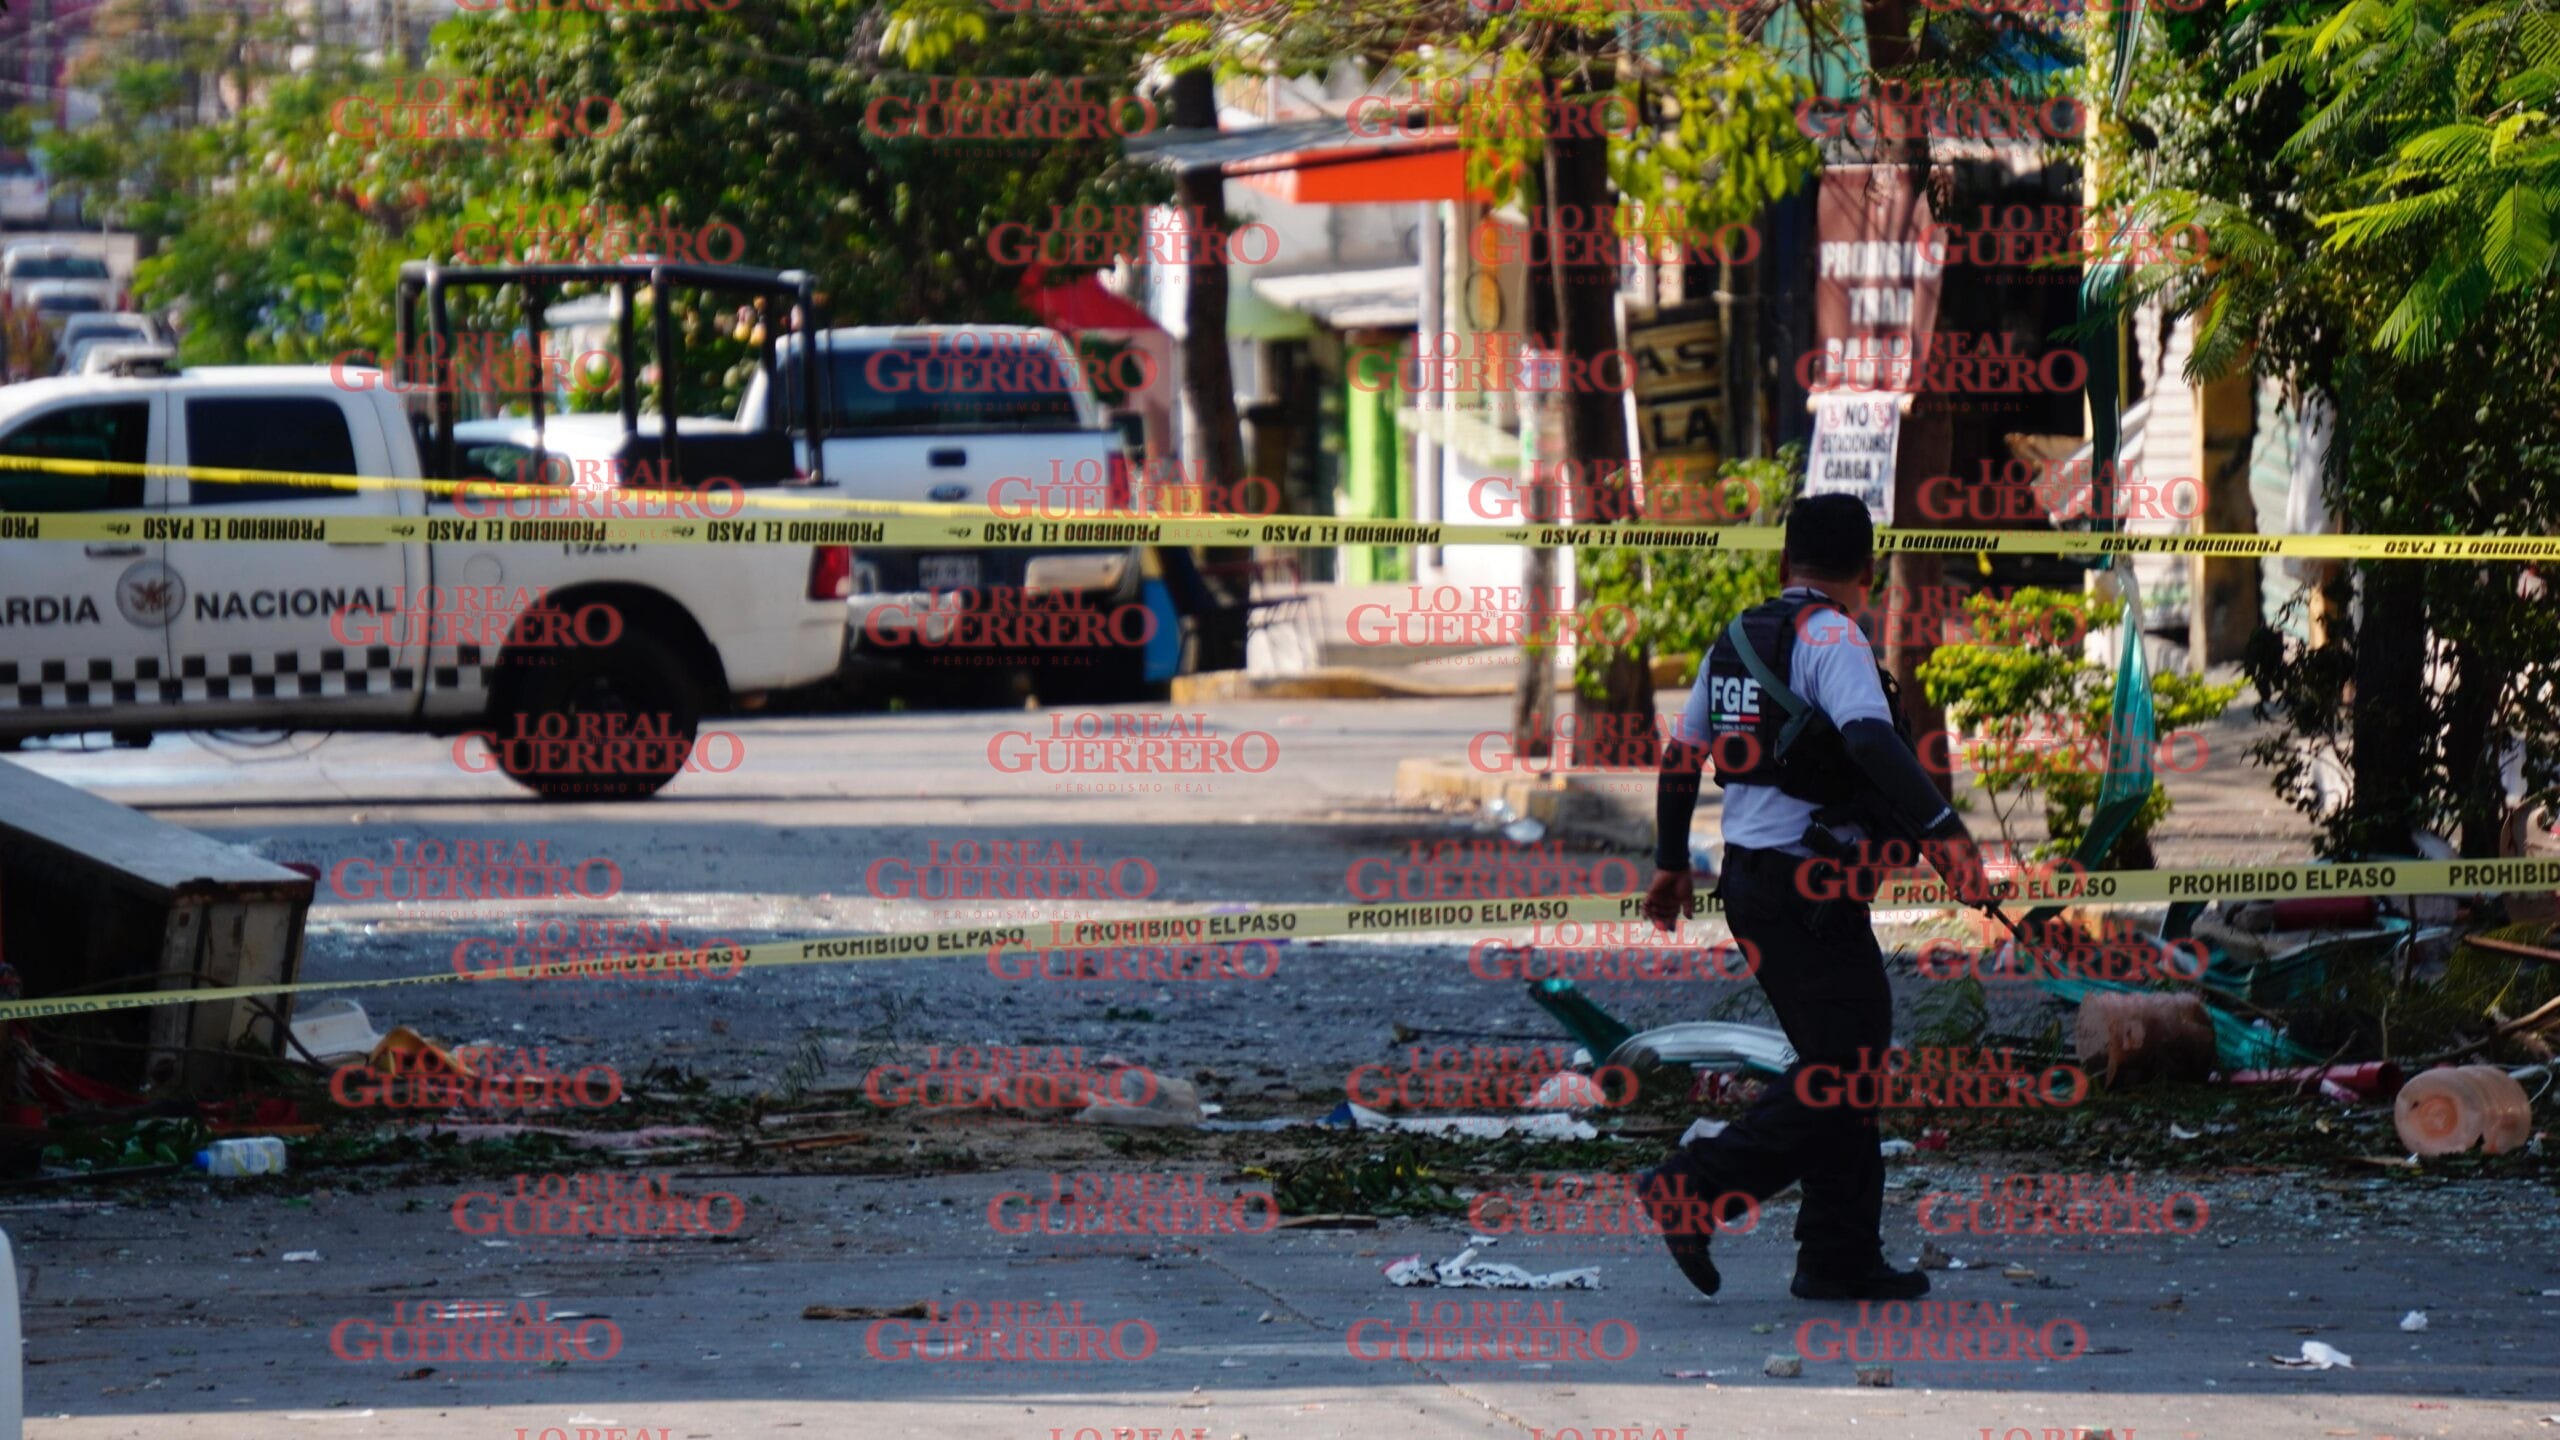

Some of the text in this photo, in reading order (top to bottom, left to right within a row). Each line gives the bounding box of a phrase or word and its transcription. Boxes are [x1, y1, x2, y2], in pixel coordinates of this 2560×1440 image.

[1844, 403, 1869, 426] NO
[143, 517, 194, 540] PASO
[228, 518, 325, 540] PROHIBIDO
[427, 519, 477, 541] PASO
[510, 520, 606, 541] PROHIBIDO
[707, 521, 756, 542] PASO
[788, 521, 884, 542] PROHIBIDO
[984, 522, 1032, 542] PASO
[1064, 523, 1161, 542] PROHIBIDO
[1262, 524, 1311, 542] PASO
[1344, 525, 1440, 543] PROHIBIDO
[195, 586, 398, 622] NACIONAL
[1711, 676, 1761, 714] FGE
[2168, 871, 2298, 895] PROHIBIDO
[1348, 905, 1474, 928] PROHIBIDO
[1078, 918, 1201, 941] PROHIBIDO
